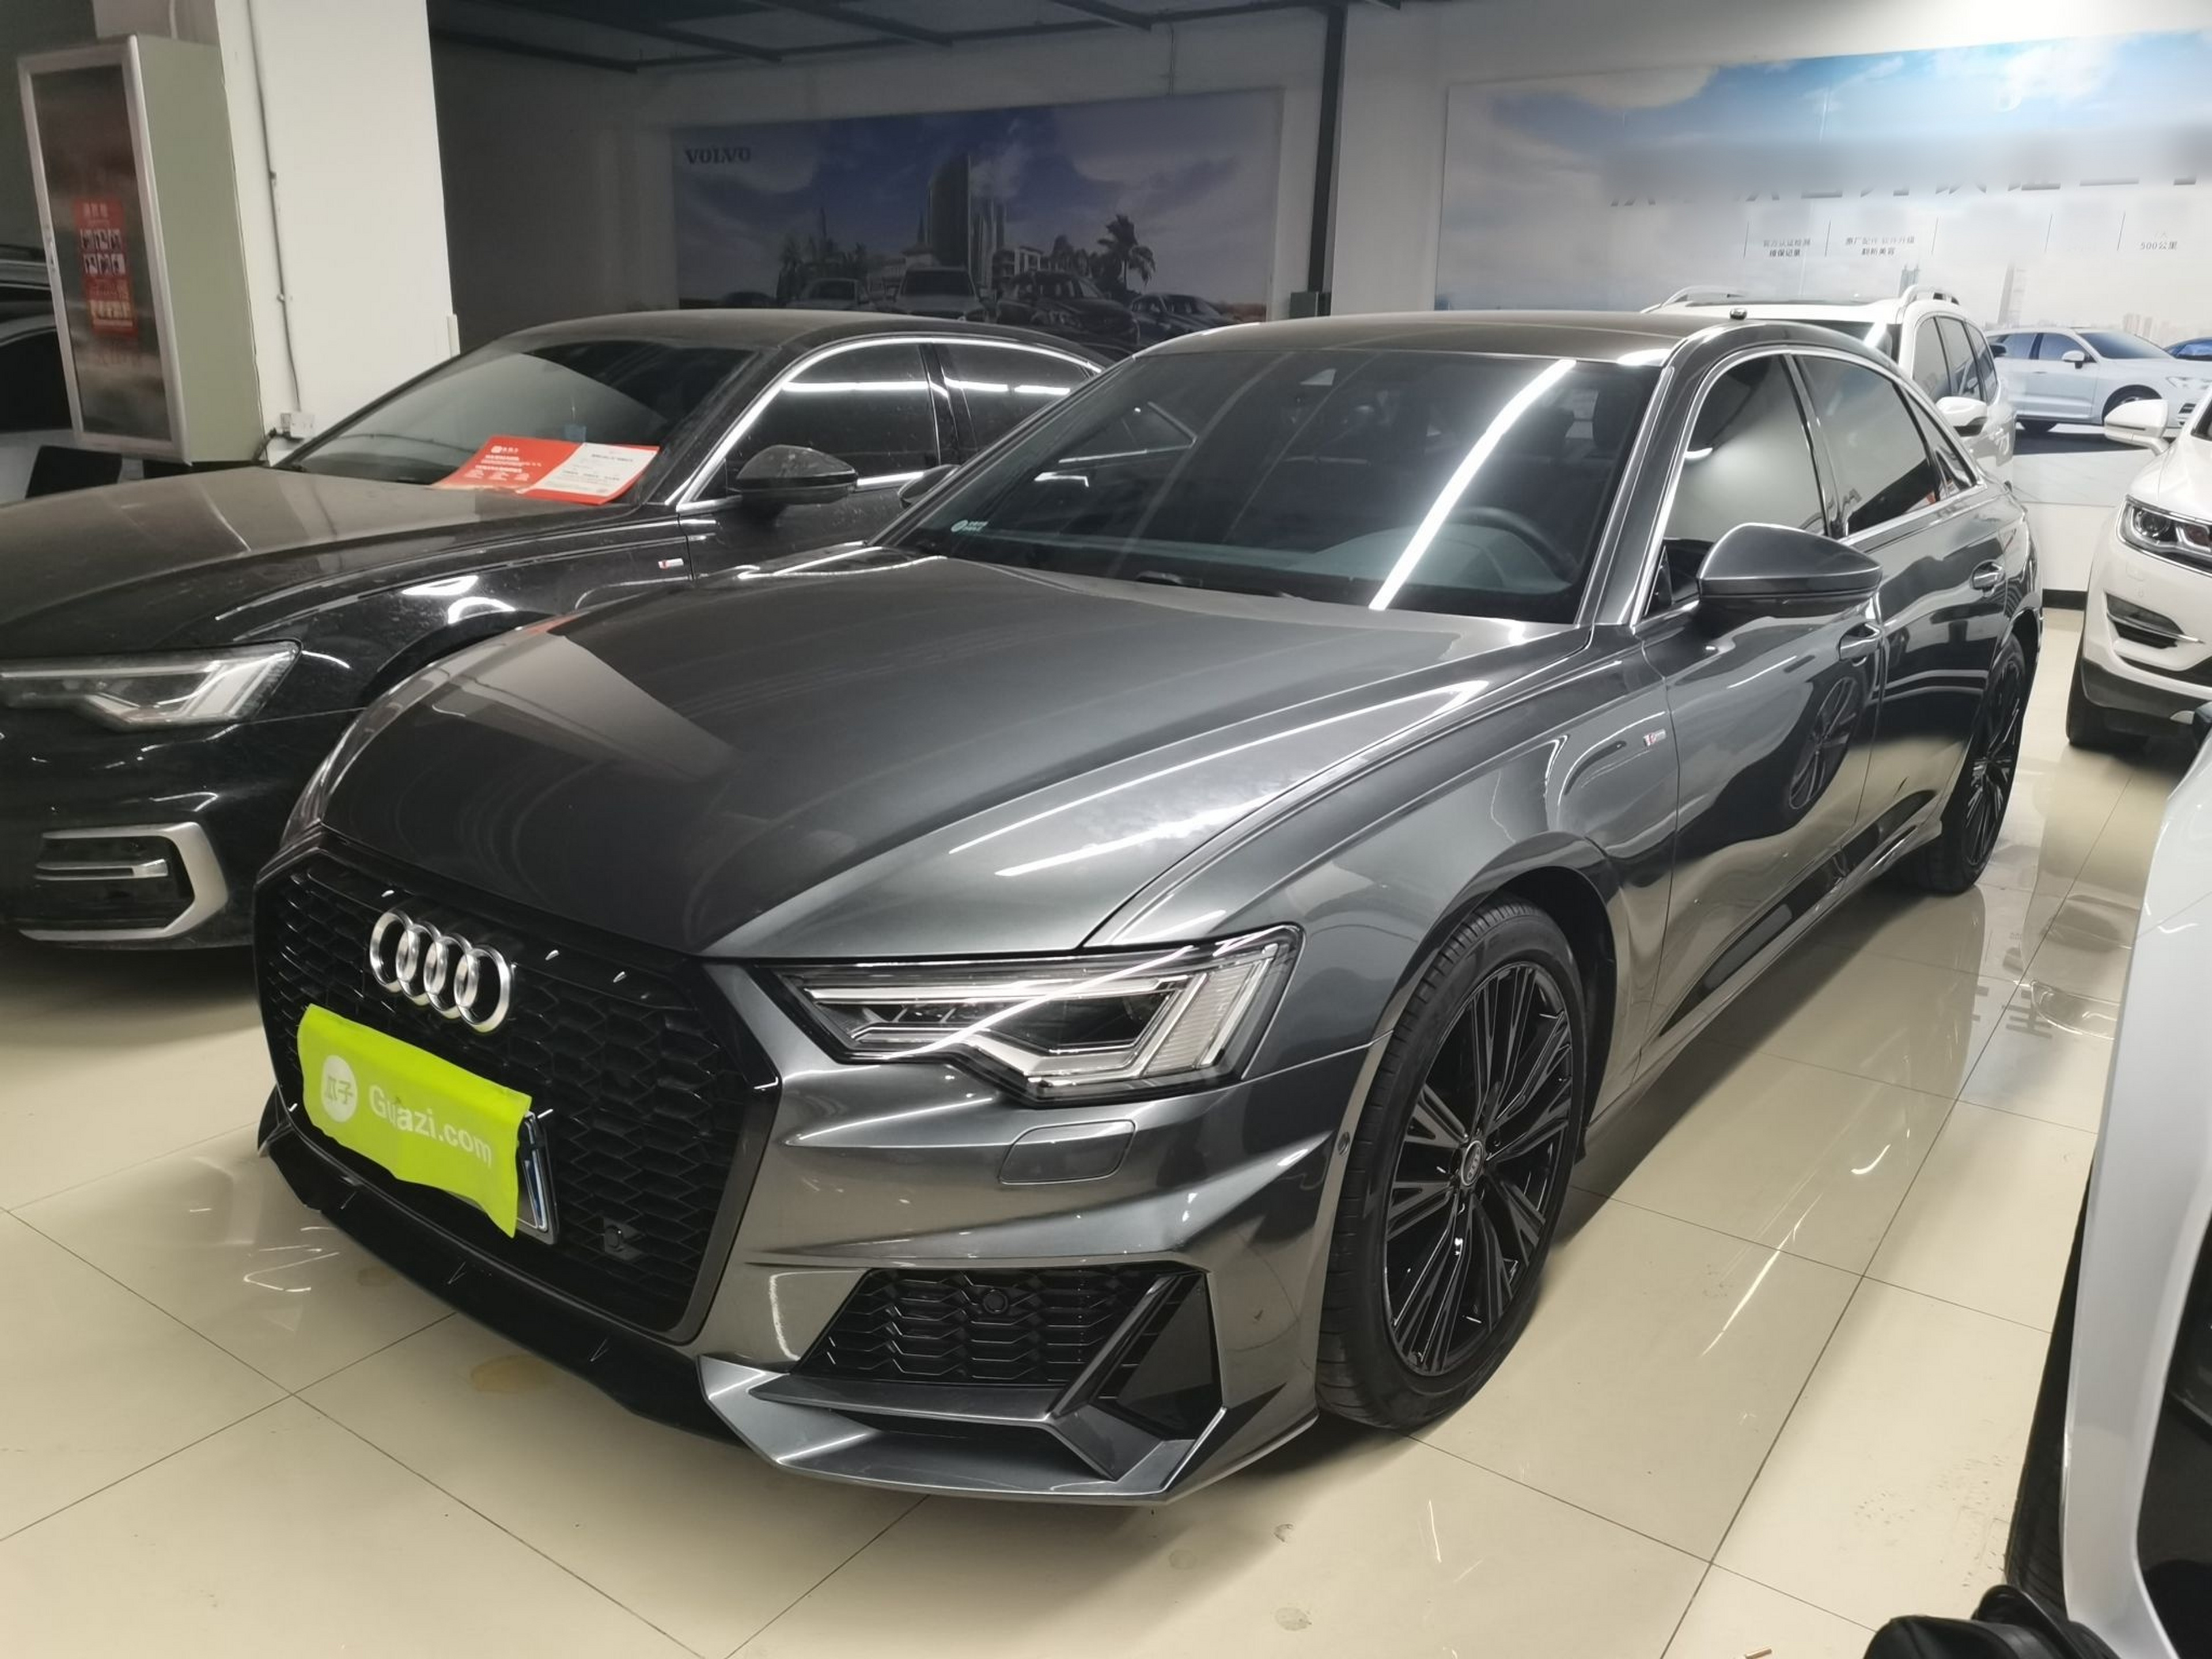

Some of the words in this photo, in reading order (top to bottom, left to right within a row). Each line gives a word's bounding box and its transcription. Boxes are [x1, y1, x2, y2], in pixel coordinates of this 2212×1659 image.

[685, 147, 751, 164] VOLVO
[327, 1075, 353, 1105] 瓜子
[369, 1085, 492, 1169] Guazi.com
